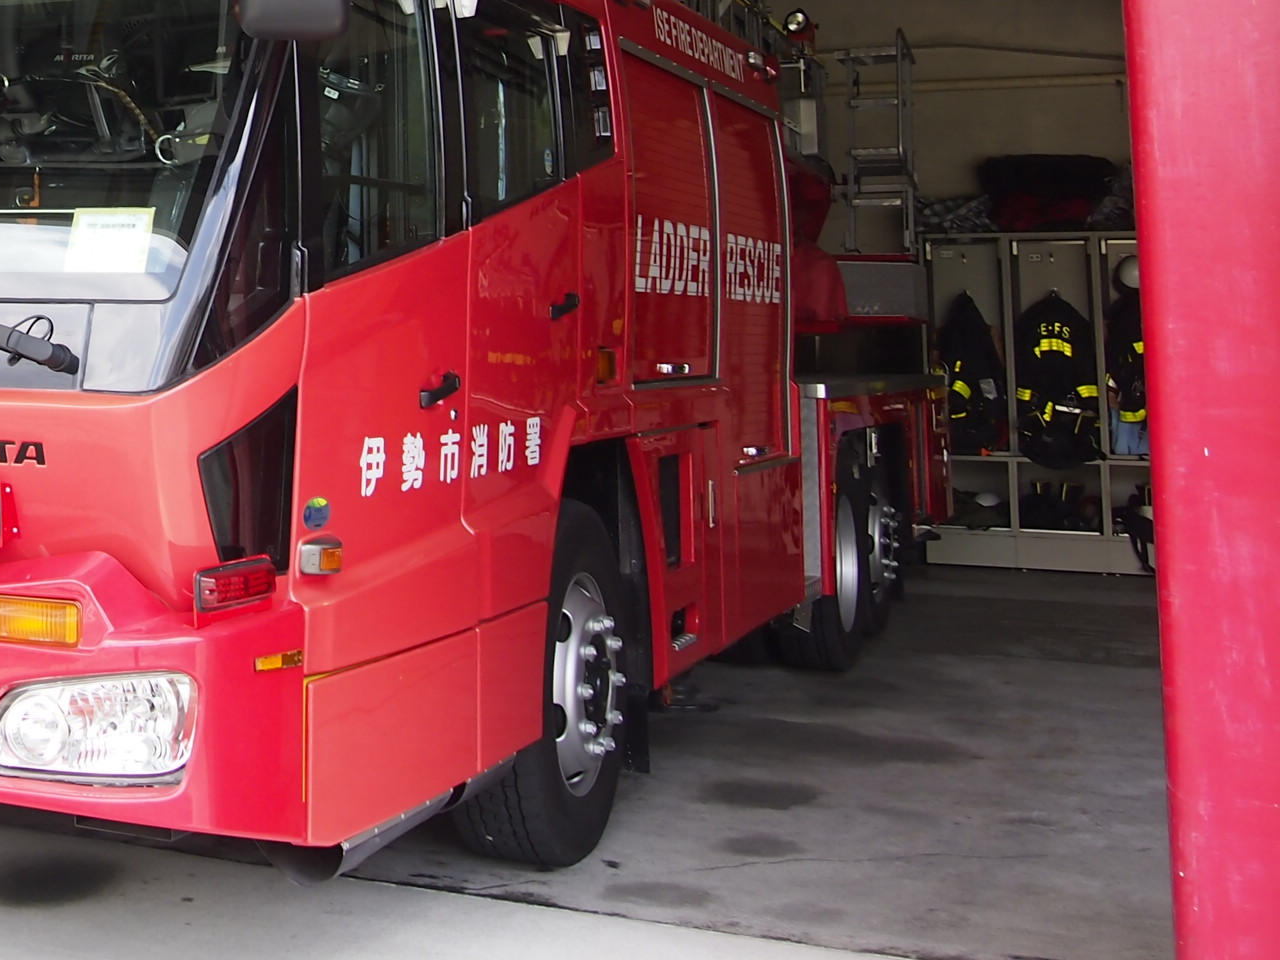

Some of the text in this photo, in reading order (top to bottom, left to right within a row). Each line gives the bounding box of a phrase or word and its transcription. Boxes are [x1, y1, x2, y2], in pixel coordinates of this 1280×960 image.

[54, 52, 95, 63] MRITA
[652, 5, 745, 84] ISE FIRE DEPARTMENT
[634, 213, 782, 305] LADDER RESCUE
[359, 416, 542, 497] 伊勢市消防署
